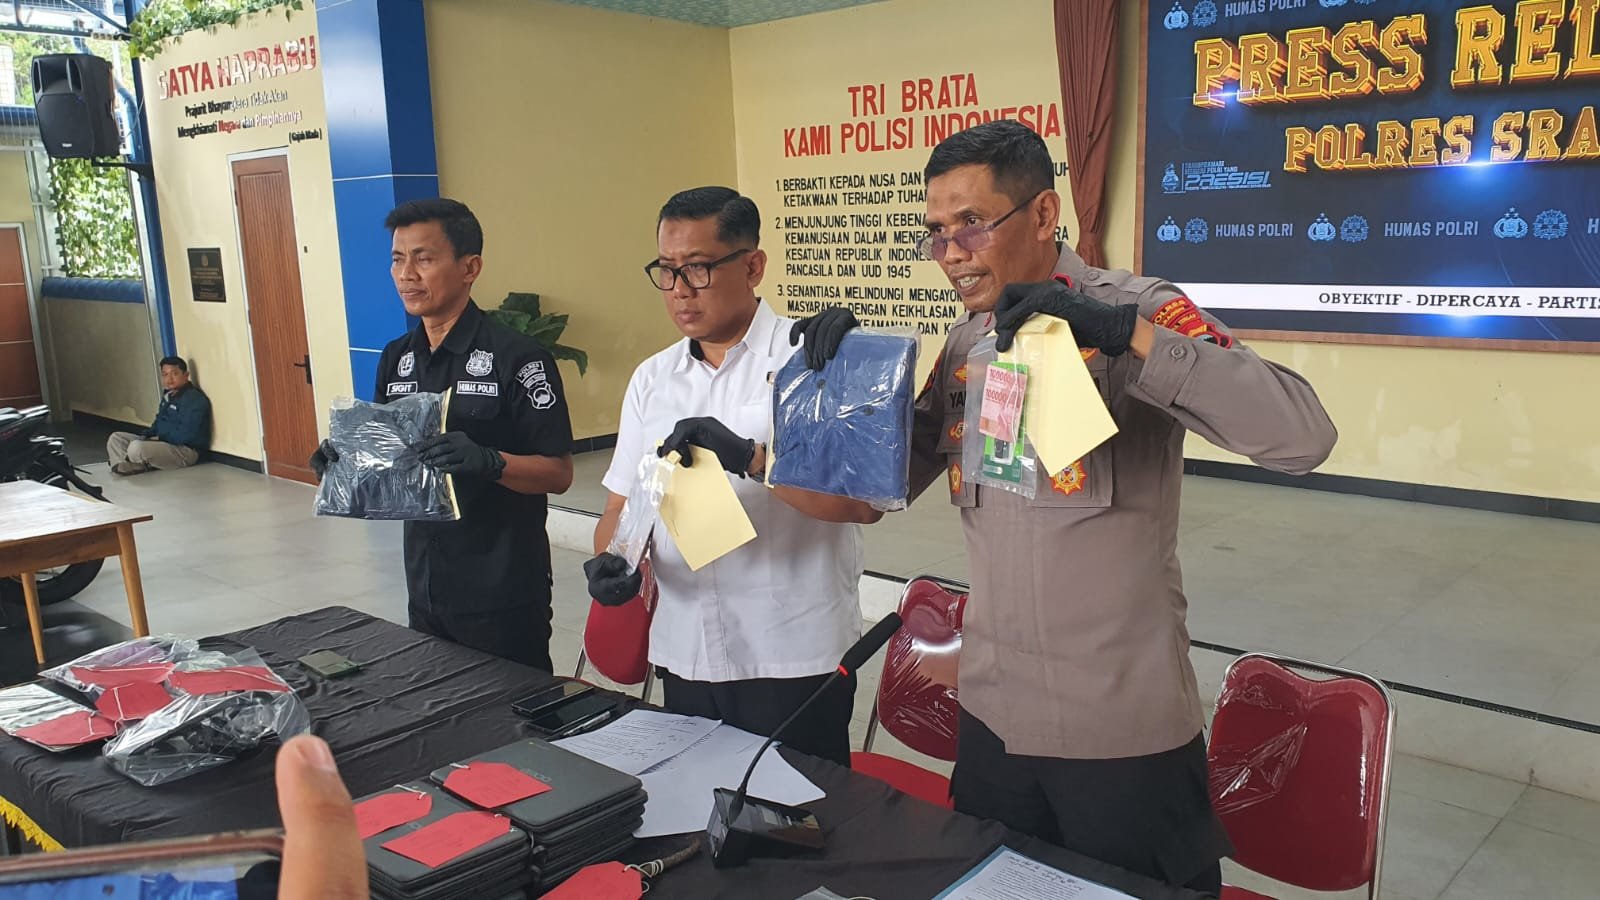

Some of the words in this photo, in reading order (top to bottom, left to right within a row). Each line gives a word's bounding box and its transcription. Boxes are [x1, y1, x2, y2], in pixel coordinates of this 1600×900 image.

[1225, 0, 1266, 17] HUMAS
[1193, 14, 1427, 108] PRESS
[1450, 0, 1600, 88] REL
[158, 61, 215, 100] SATYA
[847, 83, 886, 118] TRI
[901, 72, 979, 113] BRATA
[783, 125, 831, 158] KAMI
[840, 117, 914, 154] POLISI
[1284, 115, 1474, 172] POLRES
[1490, 106, 1600, 162] SRA
[784, 177, 826, 191] BERBAKTI
[830, 175, 865, 190] KEPADA
[870, 173, 896, 187] NUSA
[901, 171, 921, 186] DAN
[784, 194, 838, 207] KETAKWAAN
[842, 191, 894, 206] TERHADAP
[897, 189, 928, 203] TUHA
[785, 215, 847, 229] MENJUNJUNG
[849, 214, 882, 228] TINGGI
[1384, 222, 1431, 237] HUMAS
[1435, 221, 1479, 236] POLRI
[785, 231, 850, 244] KEMANUSIAAN
[854, 231, 887, 244] DALAM
[1215, 224, 1255, 238] HUMAS
[1258, 223, 1294, 237] POLRI
[786, 248, 830, 261] KESATUAN
[836, 248, 882, 261] REPUBLIK
[888, 248, 931, 261] INDONE
[786, 264, 833, 277] PANCASILA
[837, 264, 856, 277] DAN
[861, 265, 882, 277] UUD
[887, 265, 911, 279] 1945
[787, 284, 841, 298] SENANTIASA
[845, 287, 904, 301] MELINDUNGI
[1319, 293, 1403, 305] OBYEKTIF
[1416, 294, 1521, 308] DIPERCAYA
[1537, 295, 1600, 310] PARTI
[848, 303, 886, 316] DENGAN
[892, 304, 956, 318] KEIKHLASAN
[918, 322, 938, 335] DAN
[391, 385, 412, 393] SIGIT
[477, 385, 495, 394] POLRI
[950, 391, 966, 408] YA
